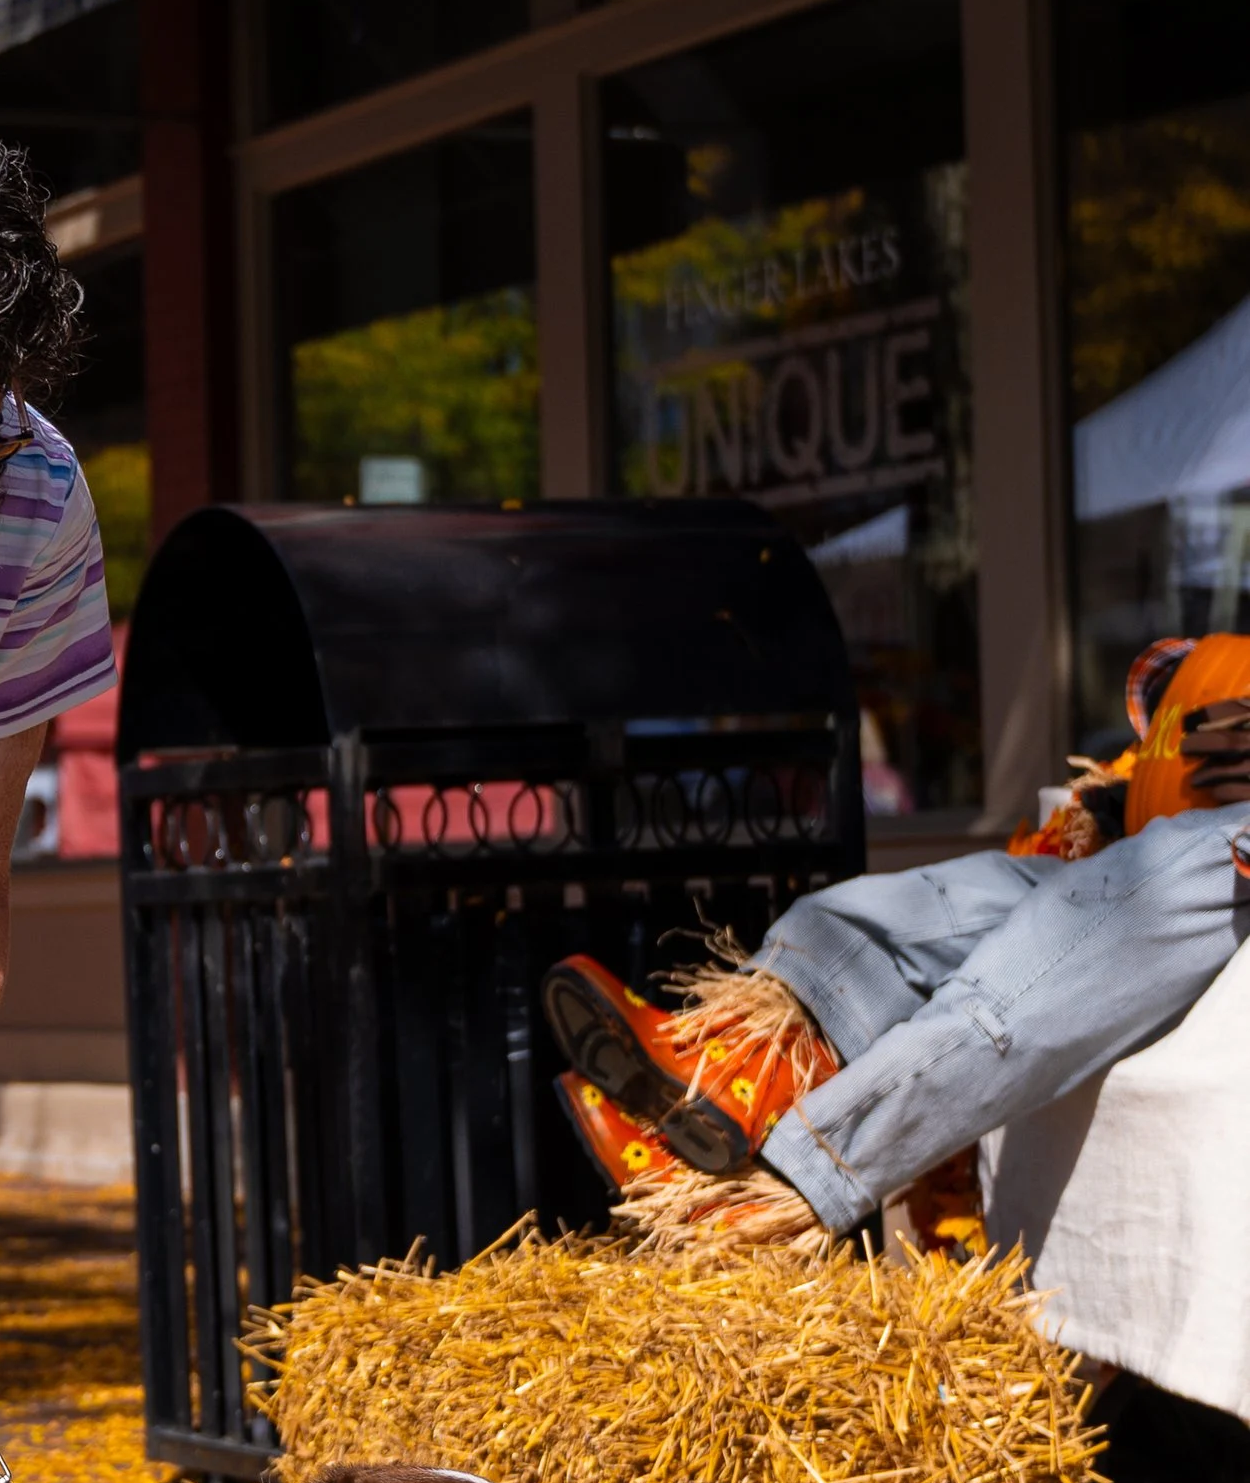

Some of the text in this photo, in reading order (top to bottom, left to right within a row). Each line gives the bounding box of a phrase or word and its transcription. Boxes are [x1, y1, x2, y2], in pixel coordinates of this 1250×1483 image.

[664, 225, 903, 331] FINGER LAKES
[646, 328, 936, 497] UNIQUE
